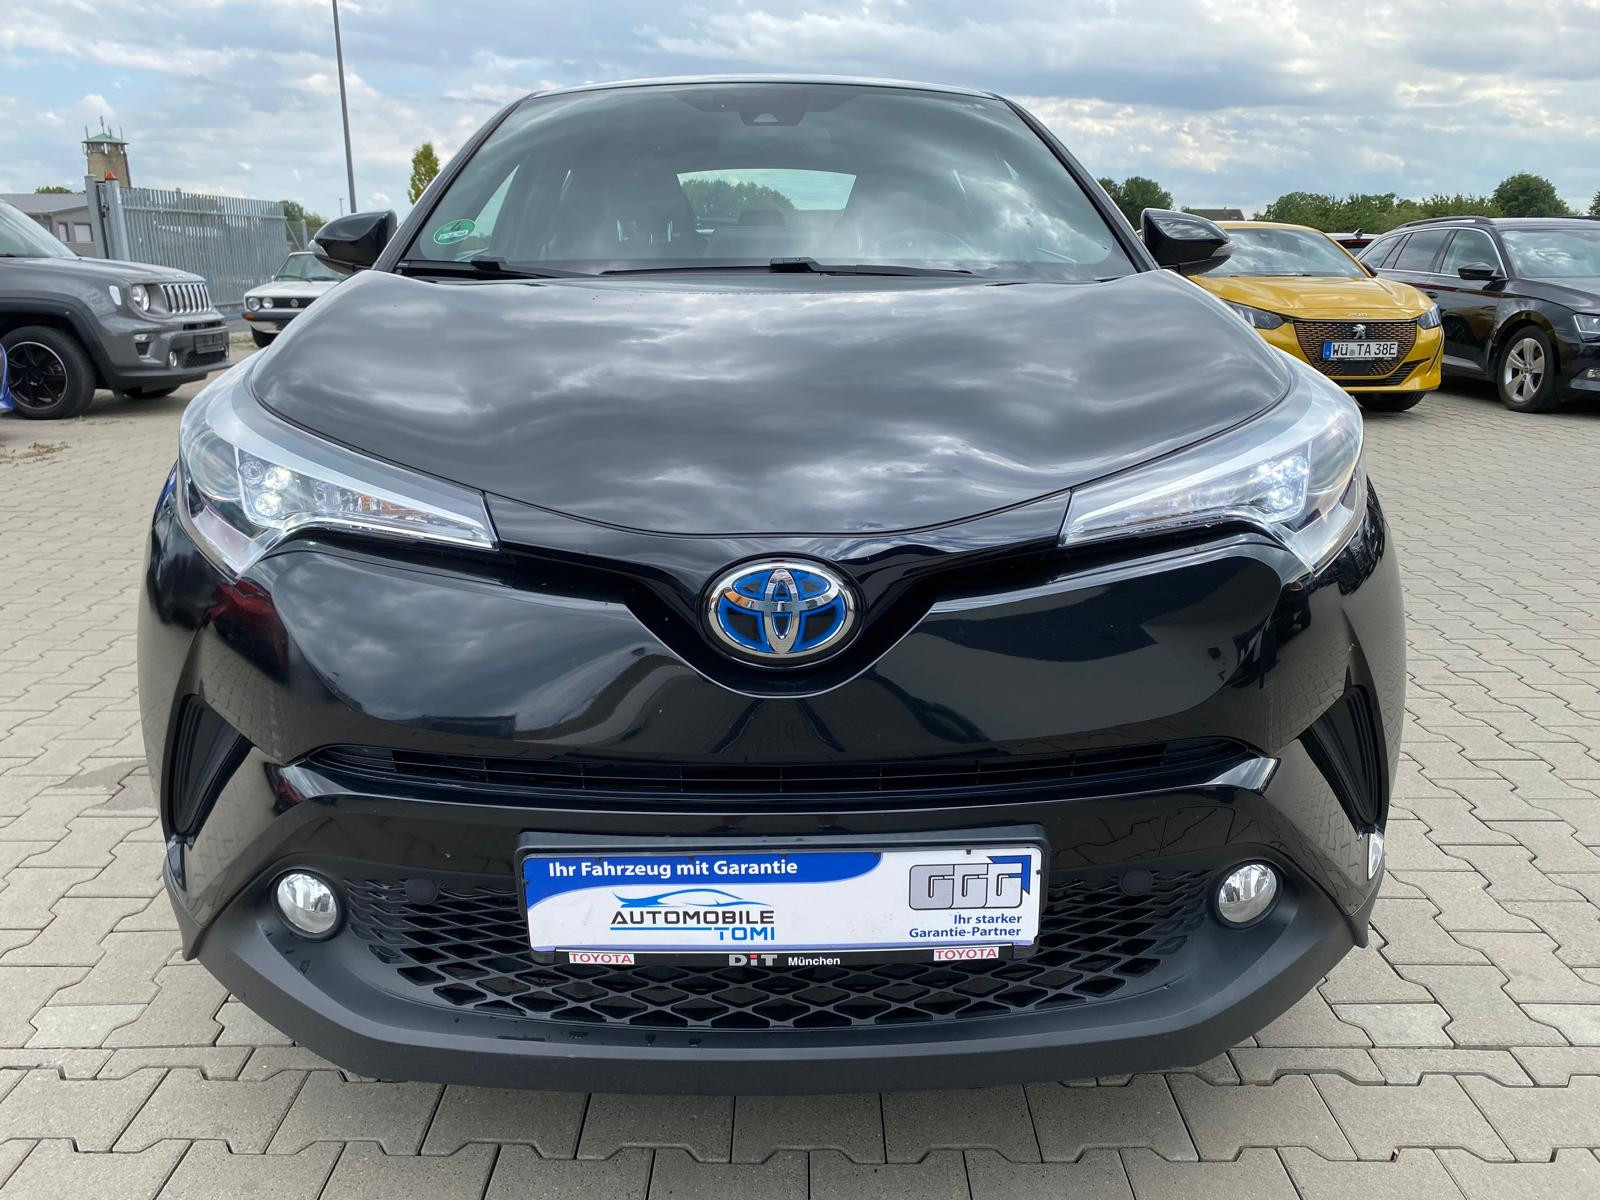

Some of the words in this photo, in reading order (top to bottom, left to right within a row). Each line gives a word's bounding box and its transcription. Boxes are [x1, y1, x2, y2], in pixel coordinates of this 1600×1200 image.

[1357, 343, 1371, 356] TA
[1374, 343, 1396, 356] 38E
[549, 862, 576, 877] Ihr
[581, 860, 671, 879] Fahrzeug
[677, 860, 709, 876] mit
[713, 859, 798, 875] Garantie
[610, 910, 775, 925] AUTOMOBILE
[953, 914, 973, 925] Ihr
[975, 913, 1022, 924] starker
[713, 926, 775, 941] TOMI
[909, 926, 1022, 938] Garantie-Partner
[569, 952, 633, 964] TOYOTA
[935, 947, 998, 960] TOYOTA
[788, 956, 841, 967] München
